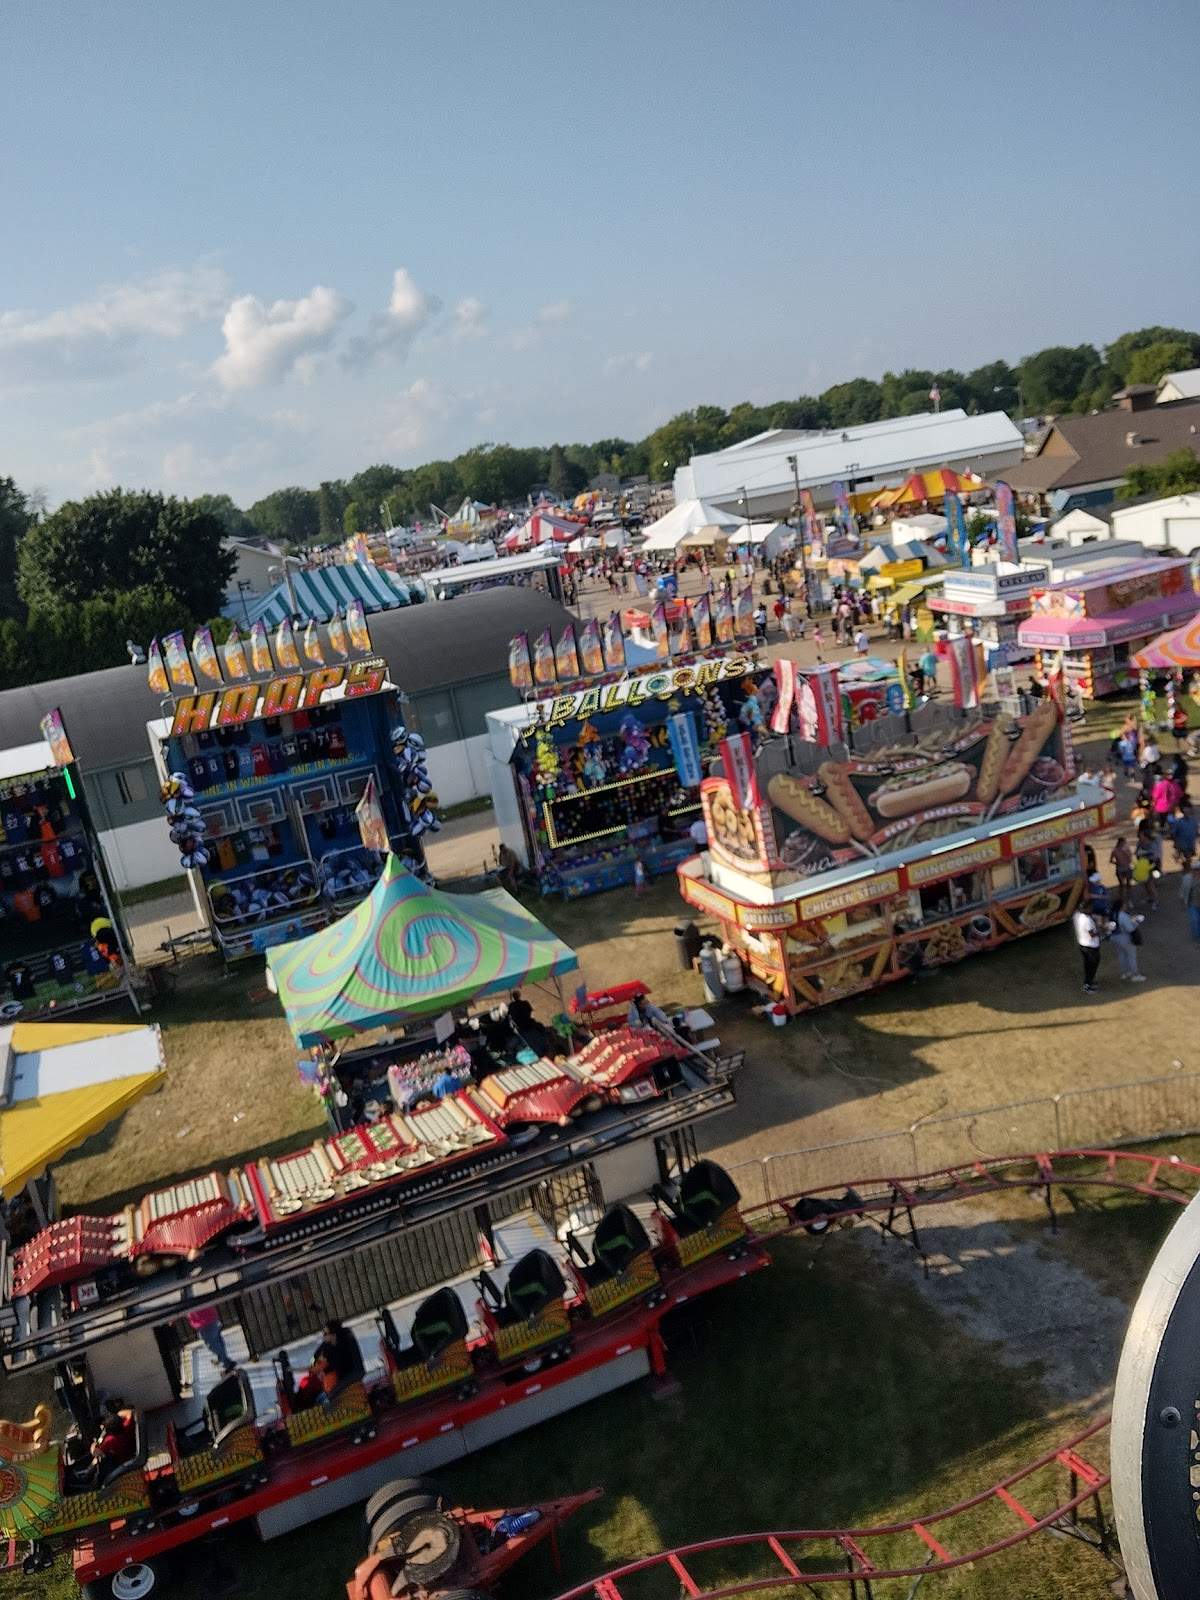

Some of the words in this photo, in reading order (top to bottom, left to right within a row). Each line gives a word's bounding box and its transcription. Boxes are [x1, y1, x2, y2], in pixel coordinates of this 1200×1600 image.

[171, 656, 387, 736] HOOPS
[550, 656, 748, 722] BALLOONS
[742, 911, 794, 926] DRINKS
[805, 892, 854, 916] CHICKEN
